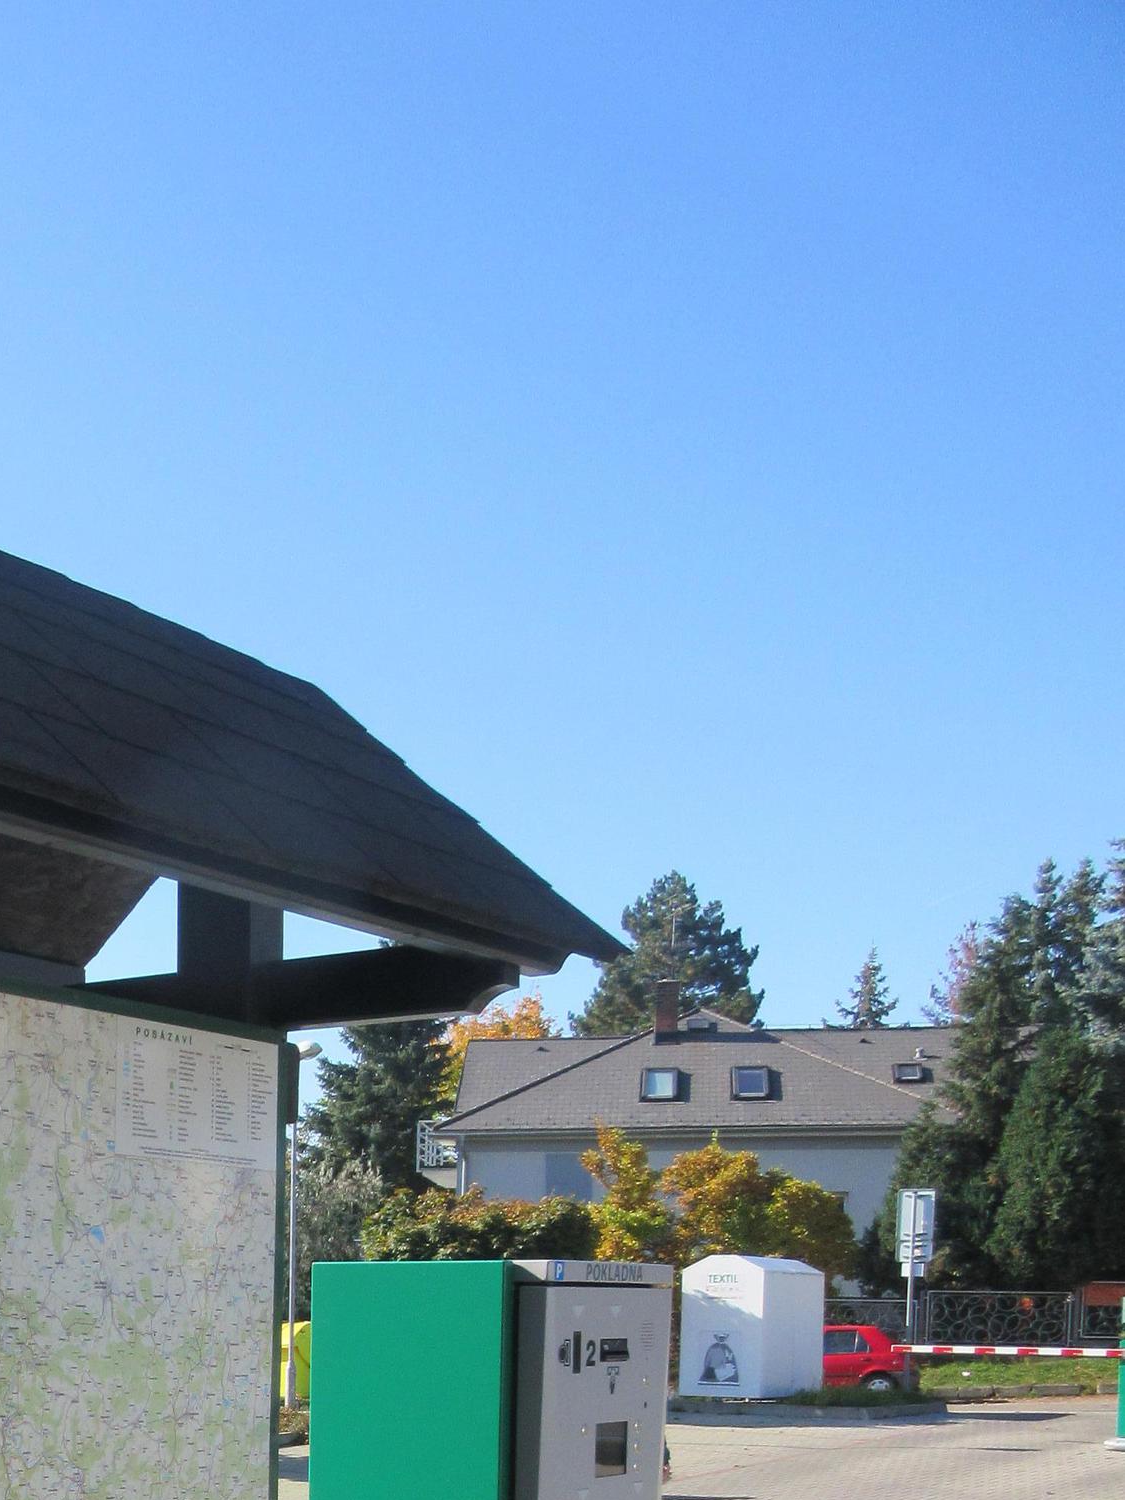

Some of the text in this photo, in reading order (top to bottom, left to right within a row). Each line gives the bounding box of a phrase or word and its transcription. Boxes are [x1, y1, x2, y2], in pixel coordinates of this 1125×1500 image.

[556, 1263, 643, 1281] P POKLADNA
[708, 1274, 738, 1284] TEXTIL
[586, 1339, 596, 1367] 2
